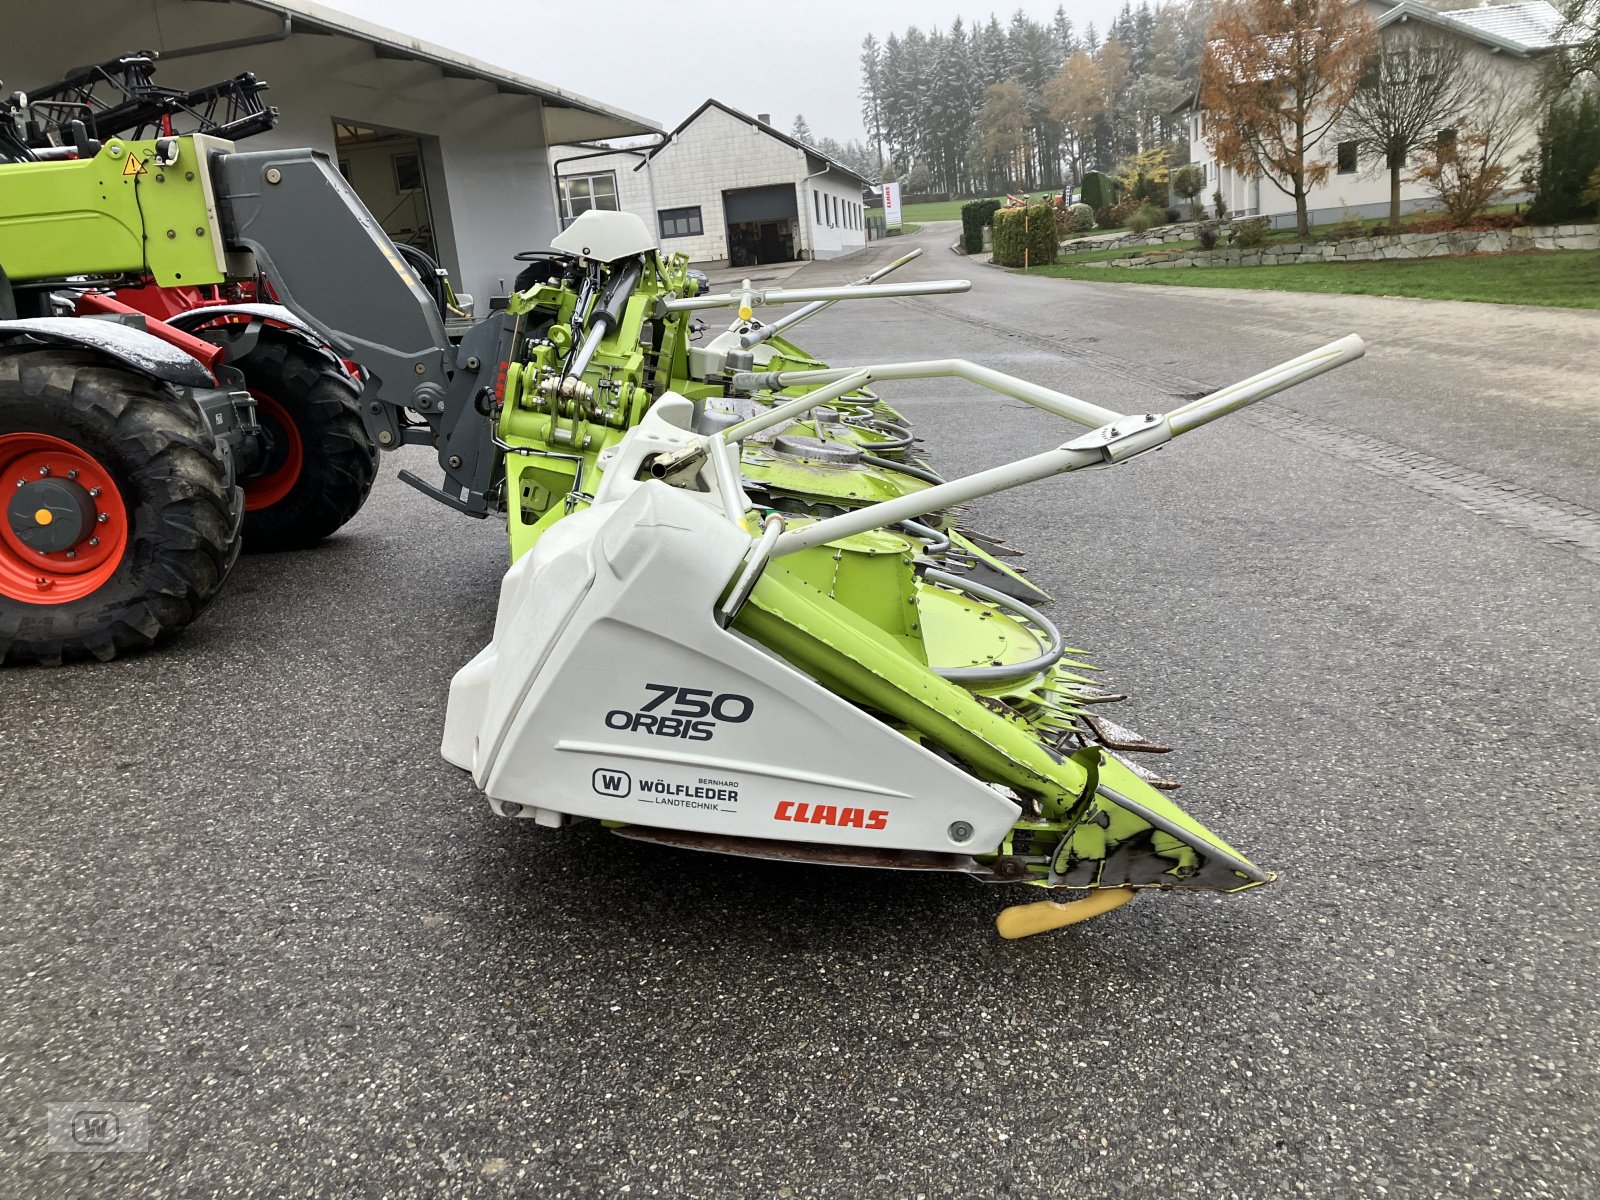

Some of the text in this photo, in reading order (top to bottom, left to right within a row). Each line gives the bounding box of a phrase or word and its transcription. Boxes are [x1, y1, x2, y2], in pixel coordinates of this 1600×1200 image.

[639, 683, 754, 723] 750
[604, 710, 716, 741] ORBIS
[601, 774, 622, 791] W
[638, 779, 739, 802] WÖLFLEDER
[698, 778, 739, 788] BERNHARD
[655, 797, 719, 811] LANDTECHNIK
[773, 800, 889, 830] CLAAS
